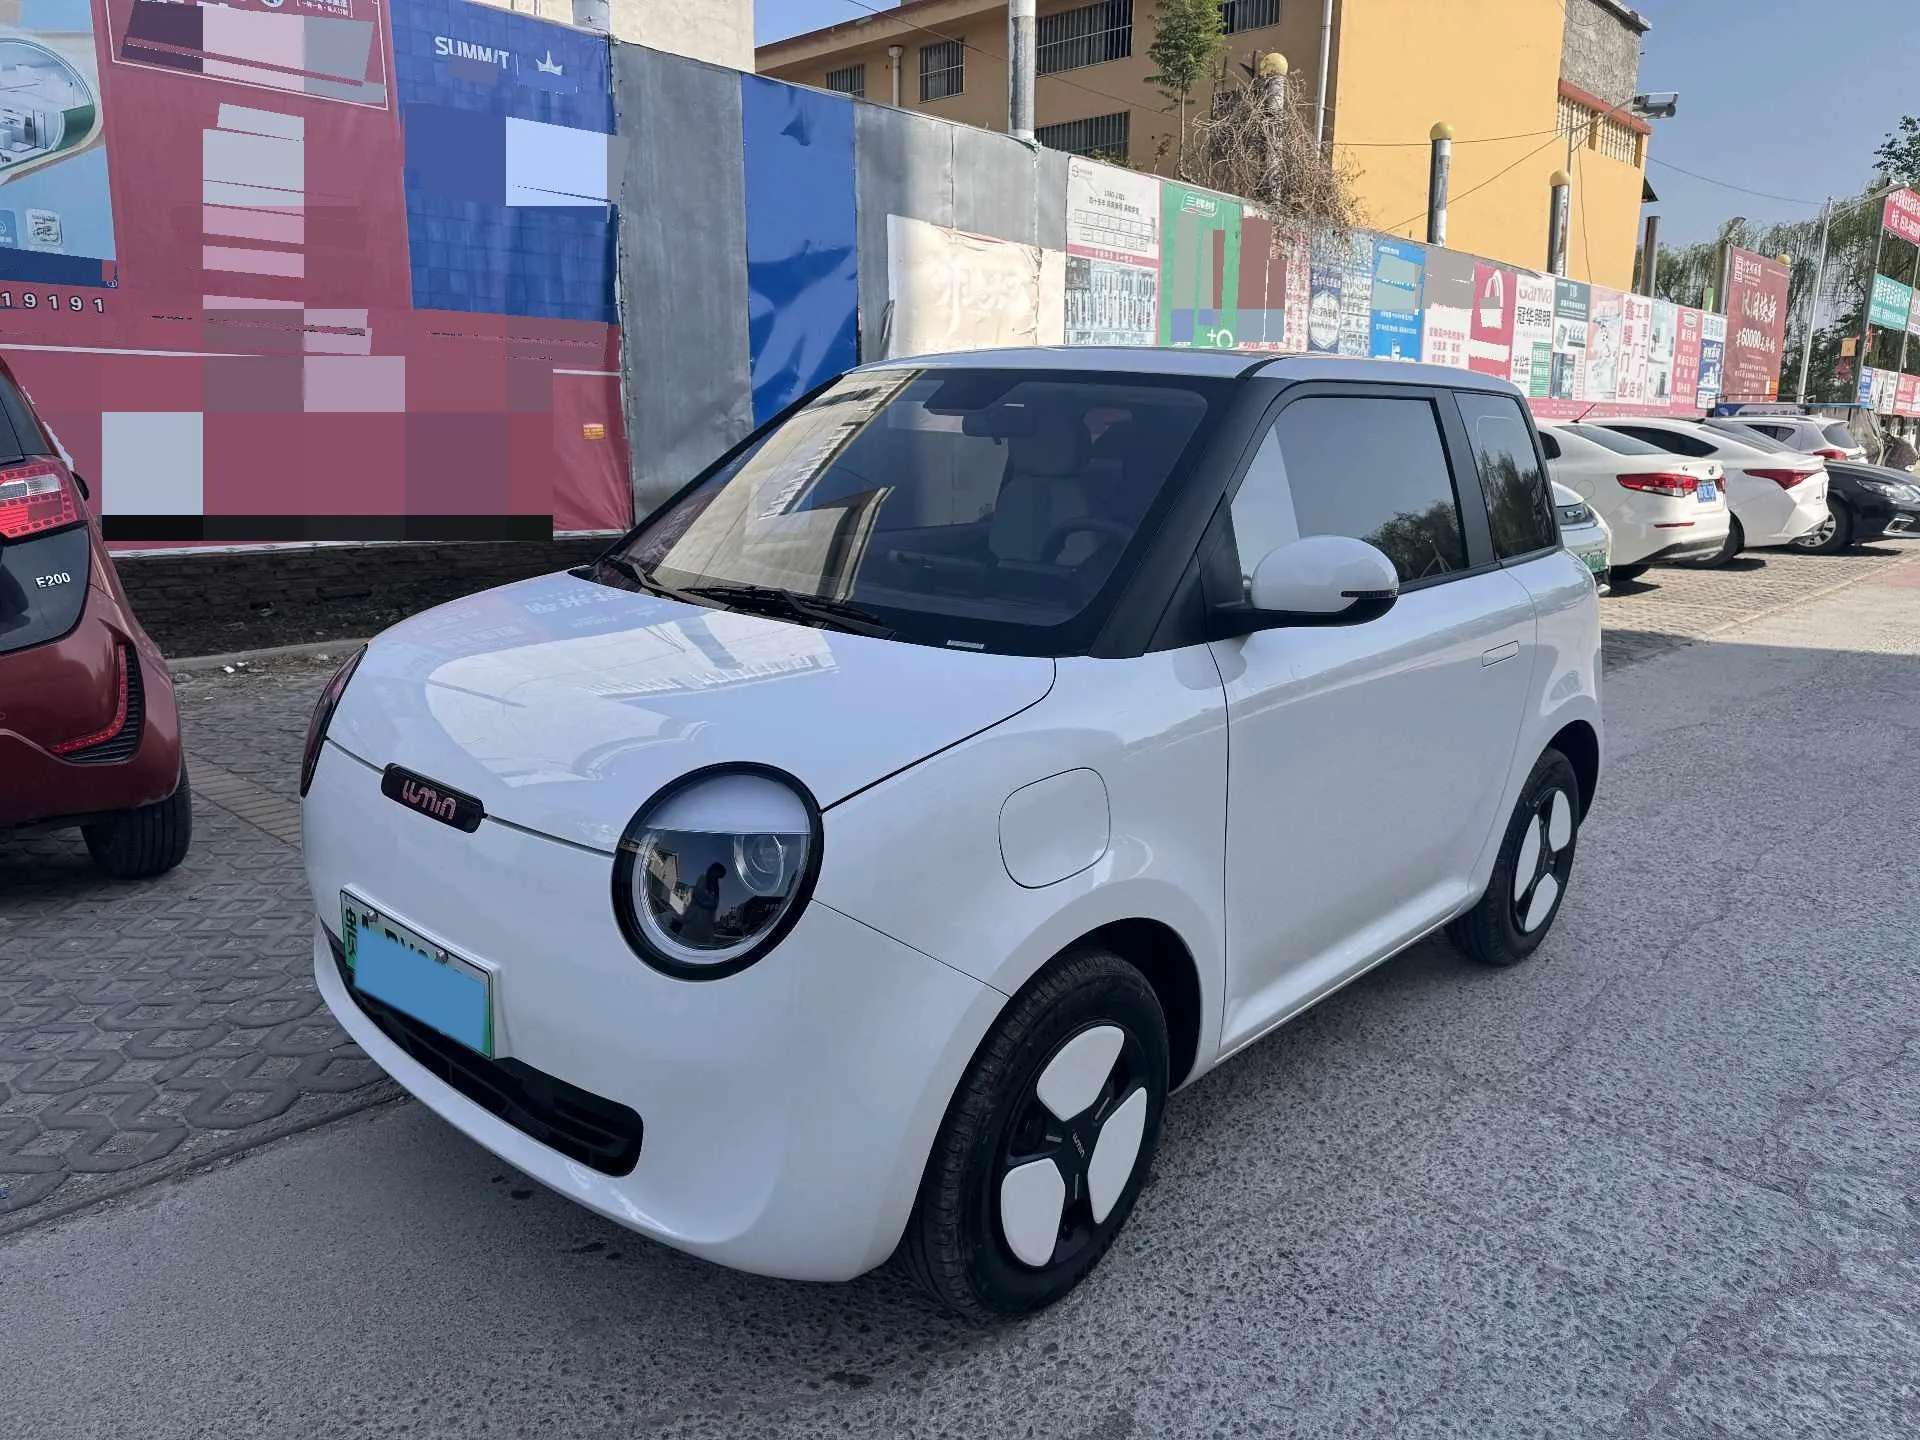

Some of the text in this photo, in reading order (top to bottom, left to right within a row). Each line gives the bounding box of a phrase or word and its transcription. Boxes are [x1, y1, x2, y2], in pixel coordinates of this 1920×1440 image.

[434, 35, 510, 70] SUMMIT
[1516, 305, 1551, 328] 冠华照明
[35, 572, 71, 588] E200
